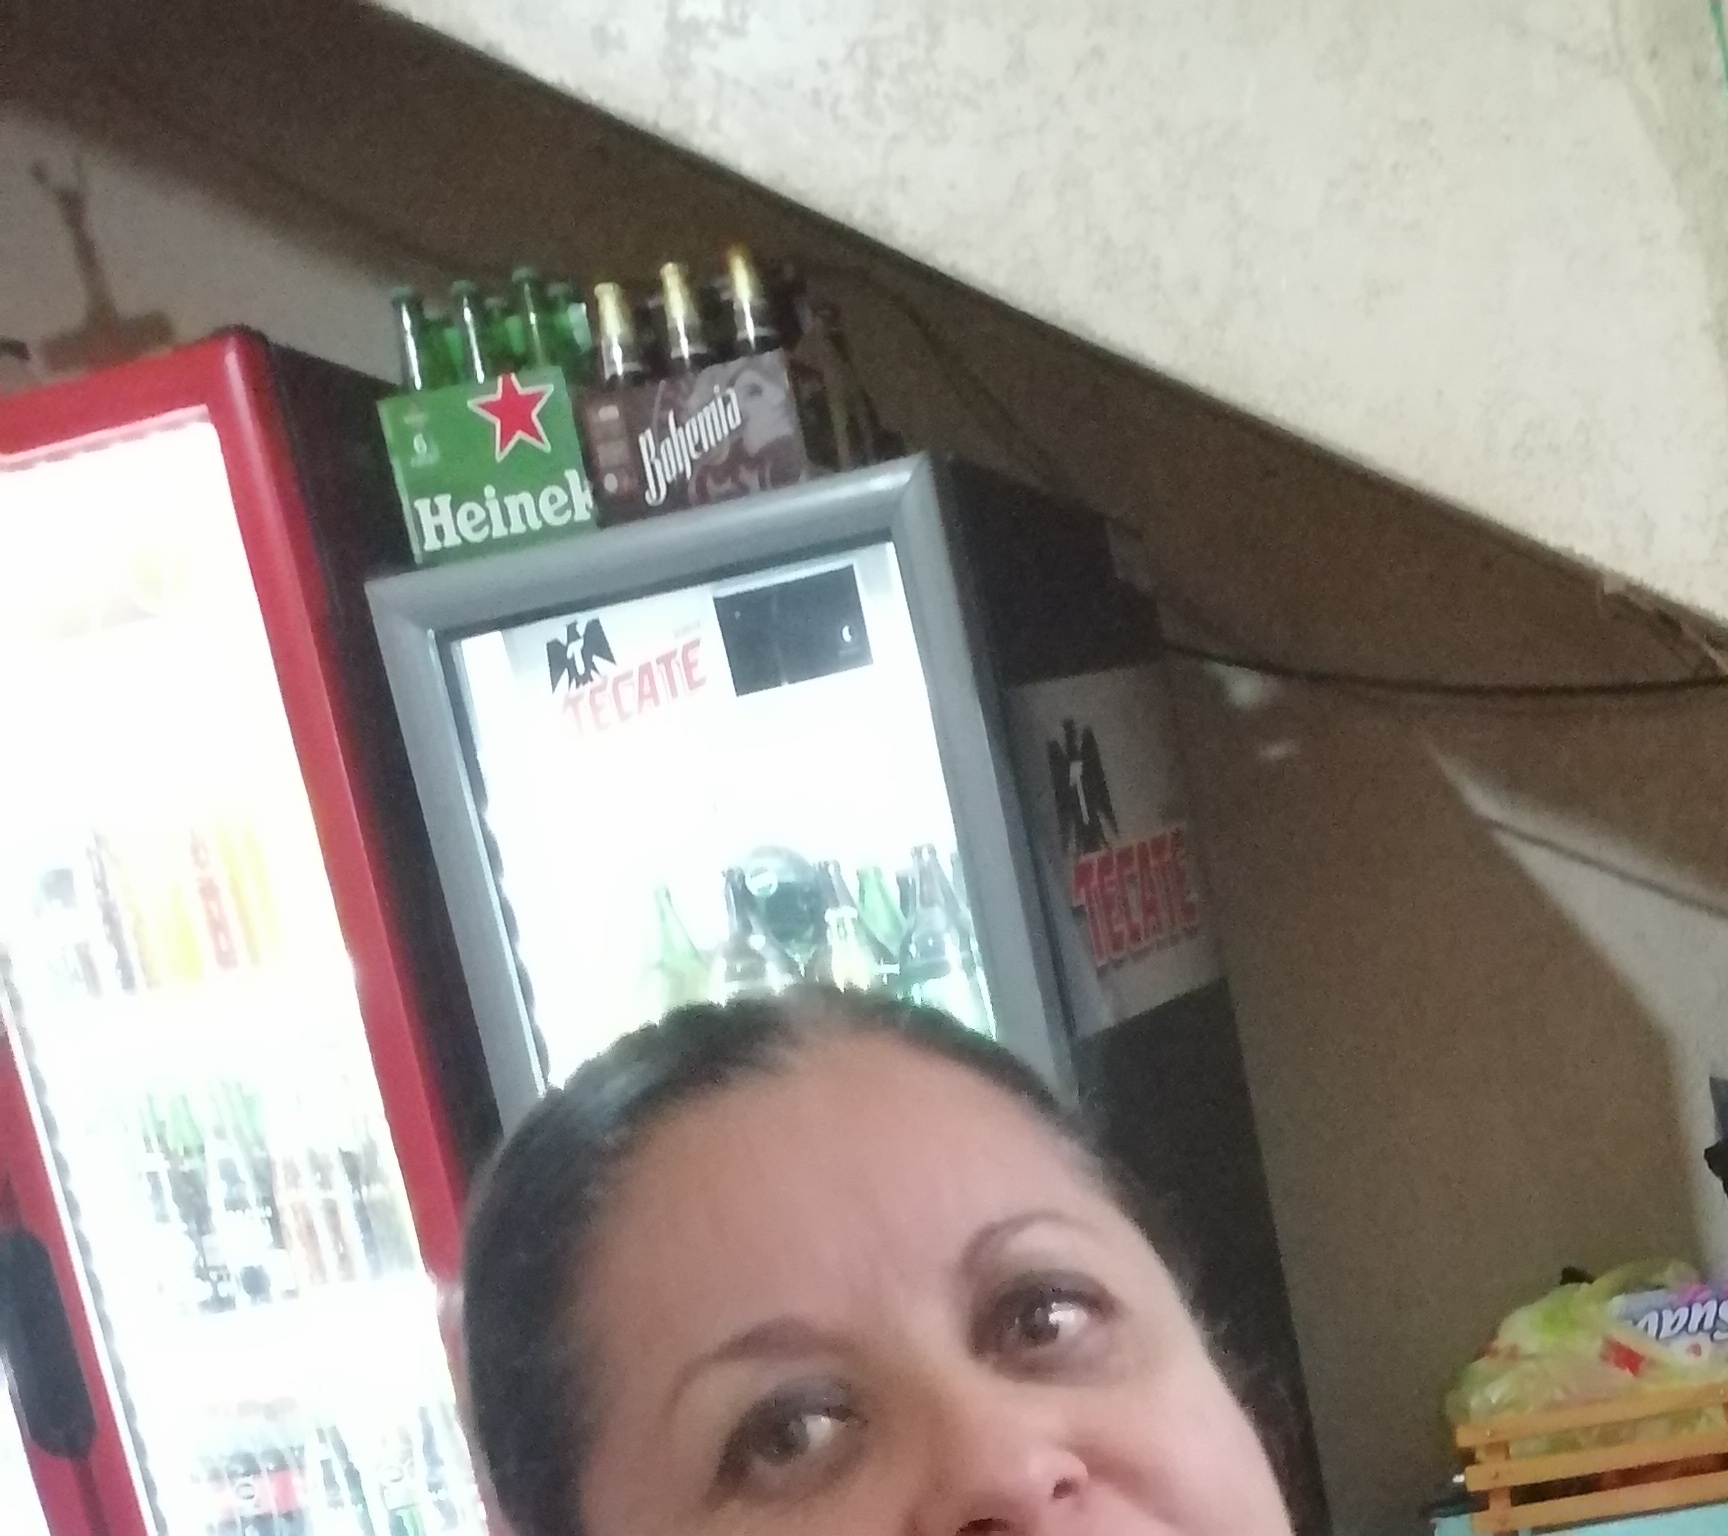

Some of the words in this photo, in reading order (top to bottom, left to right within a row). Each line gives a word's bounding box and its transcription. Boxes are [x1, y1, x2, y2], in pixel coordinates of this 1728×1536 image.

[637, 384, 742, 507] Bohemia
[563, 637, 708, 735] TECATE
[1073, 826, 1198, 968] TECATE
